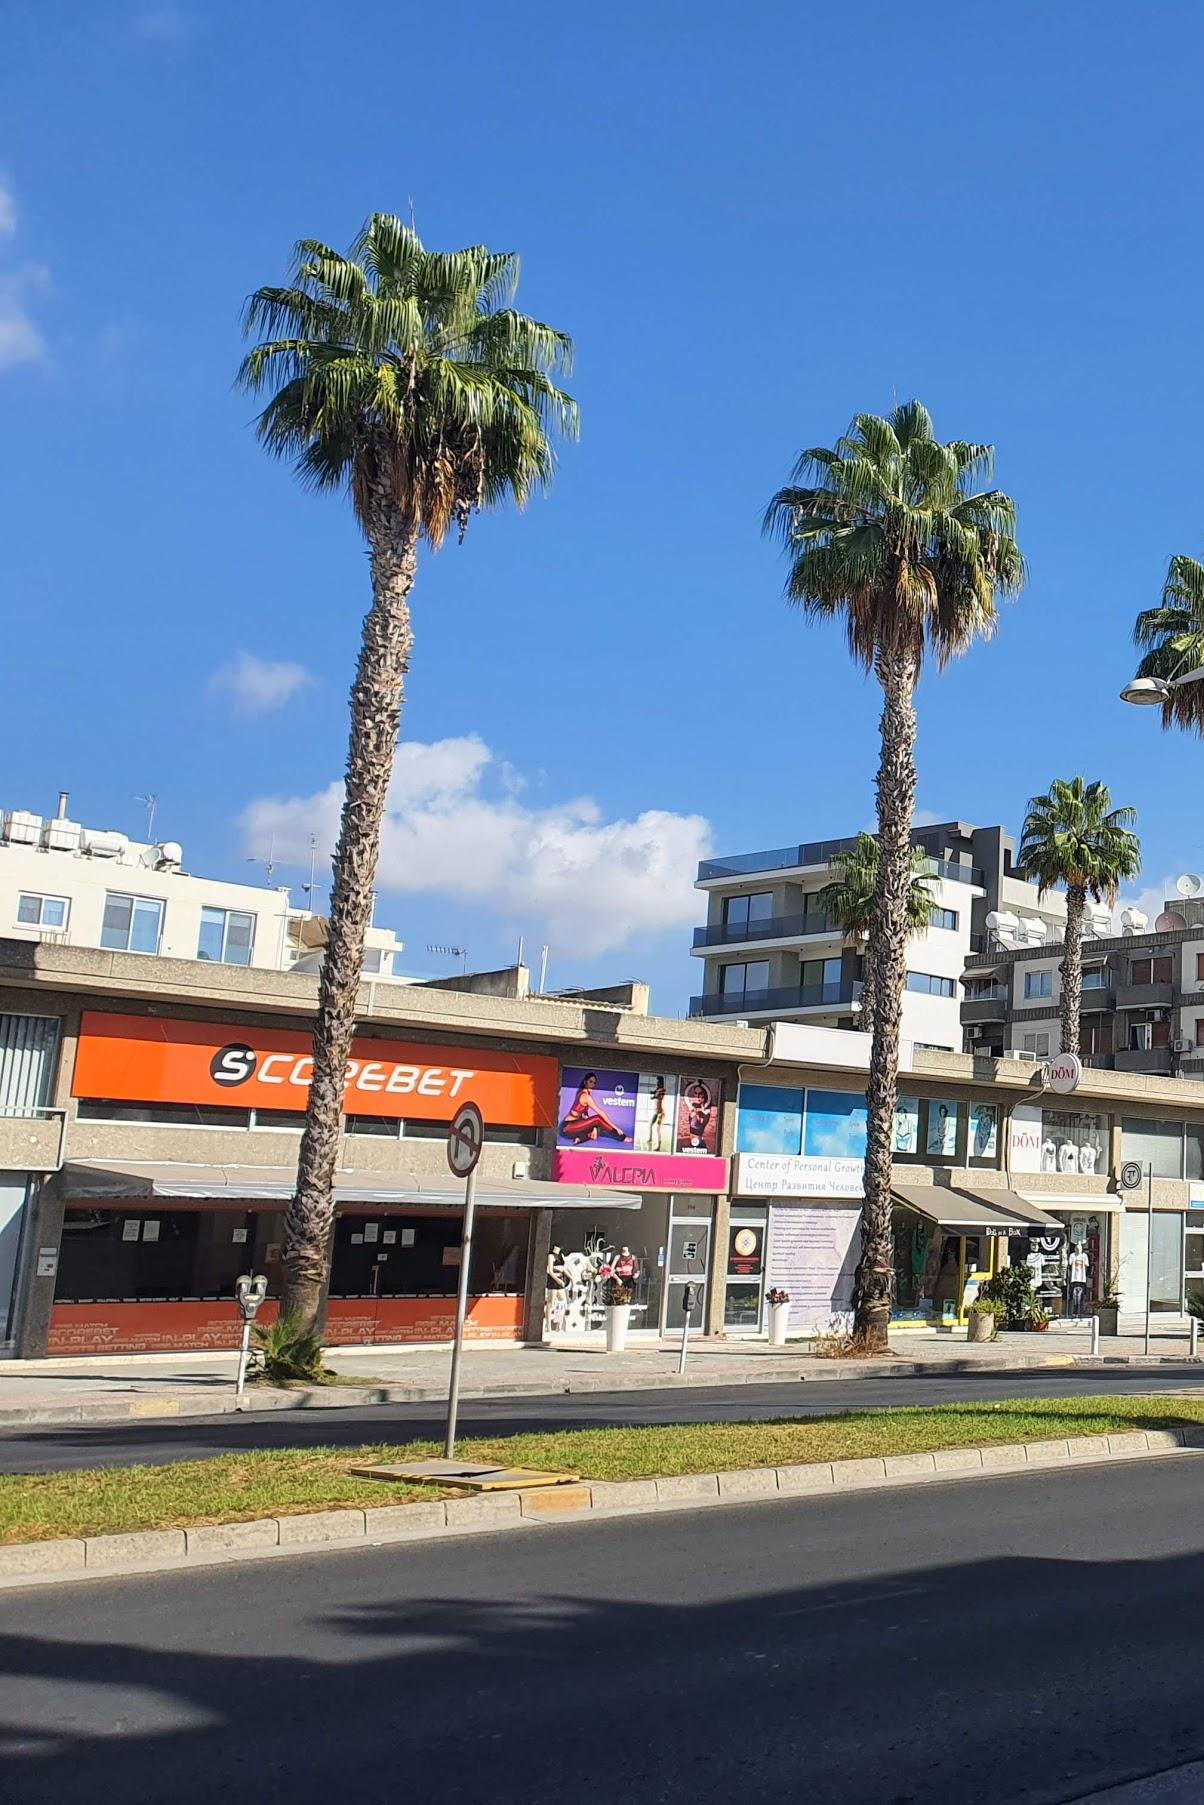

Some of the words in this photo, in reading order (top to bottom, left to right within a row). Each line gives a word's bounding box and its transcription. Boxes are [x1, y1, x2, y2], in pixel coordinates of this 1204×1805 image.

[602, 1097, 635, 1107] vestem
[747, 1158, 780, 1170] Center
[782, 1159, 793, 1174] of
[794, 1159, 832, 1173] Personal
[745, 1178, 778, 1192] Центр
[781, 1179, 826, 1191] Развития
